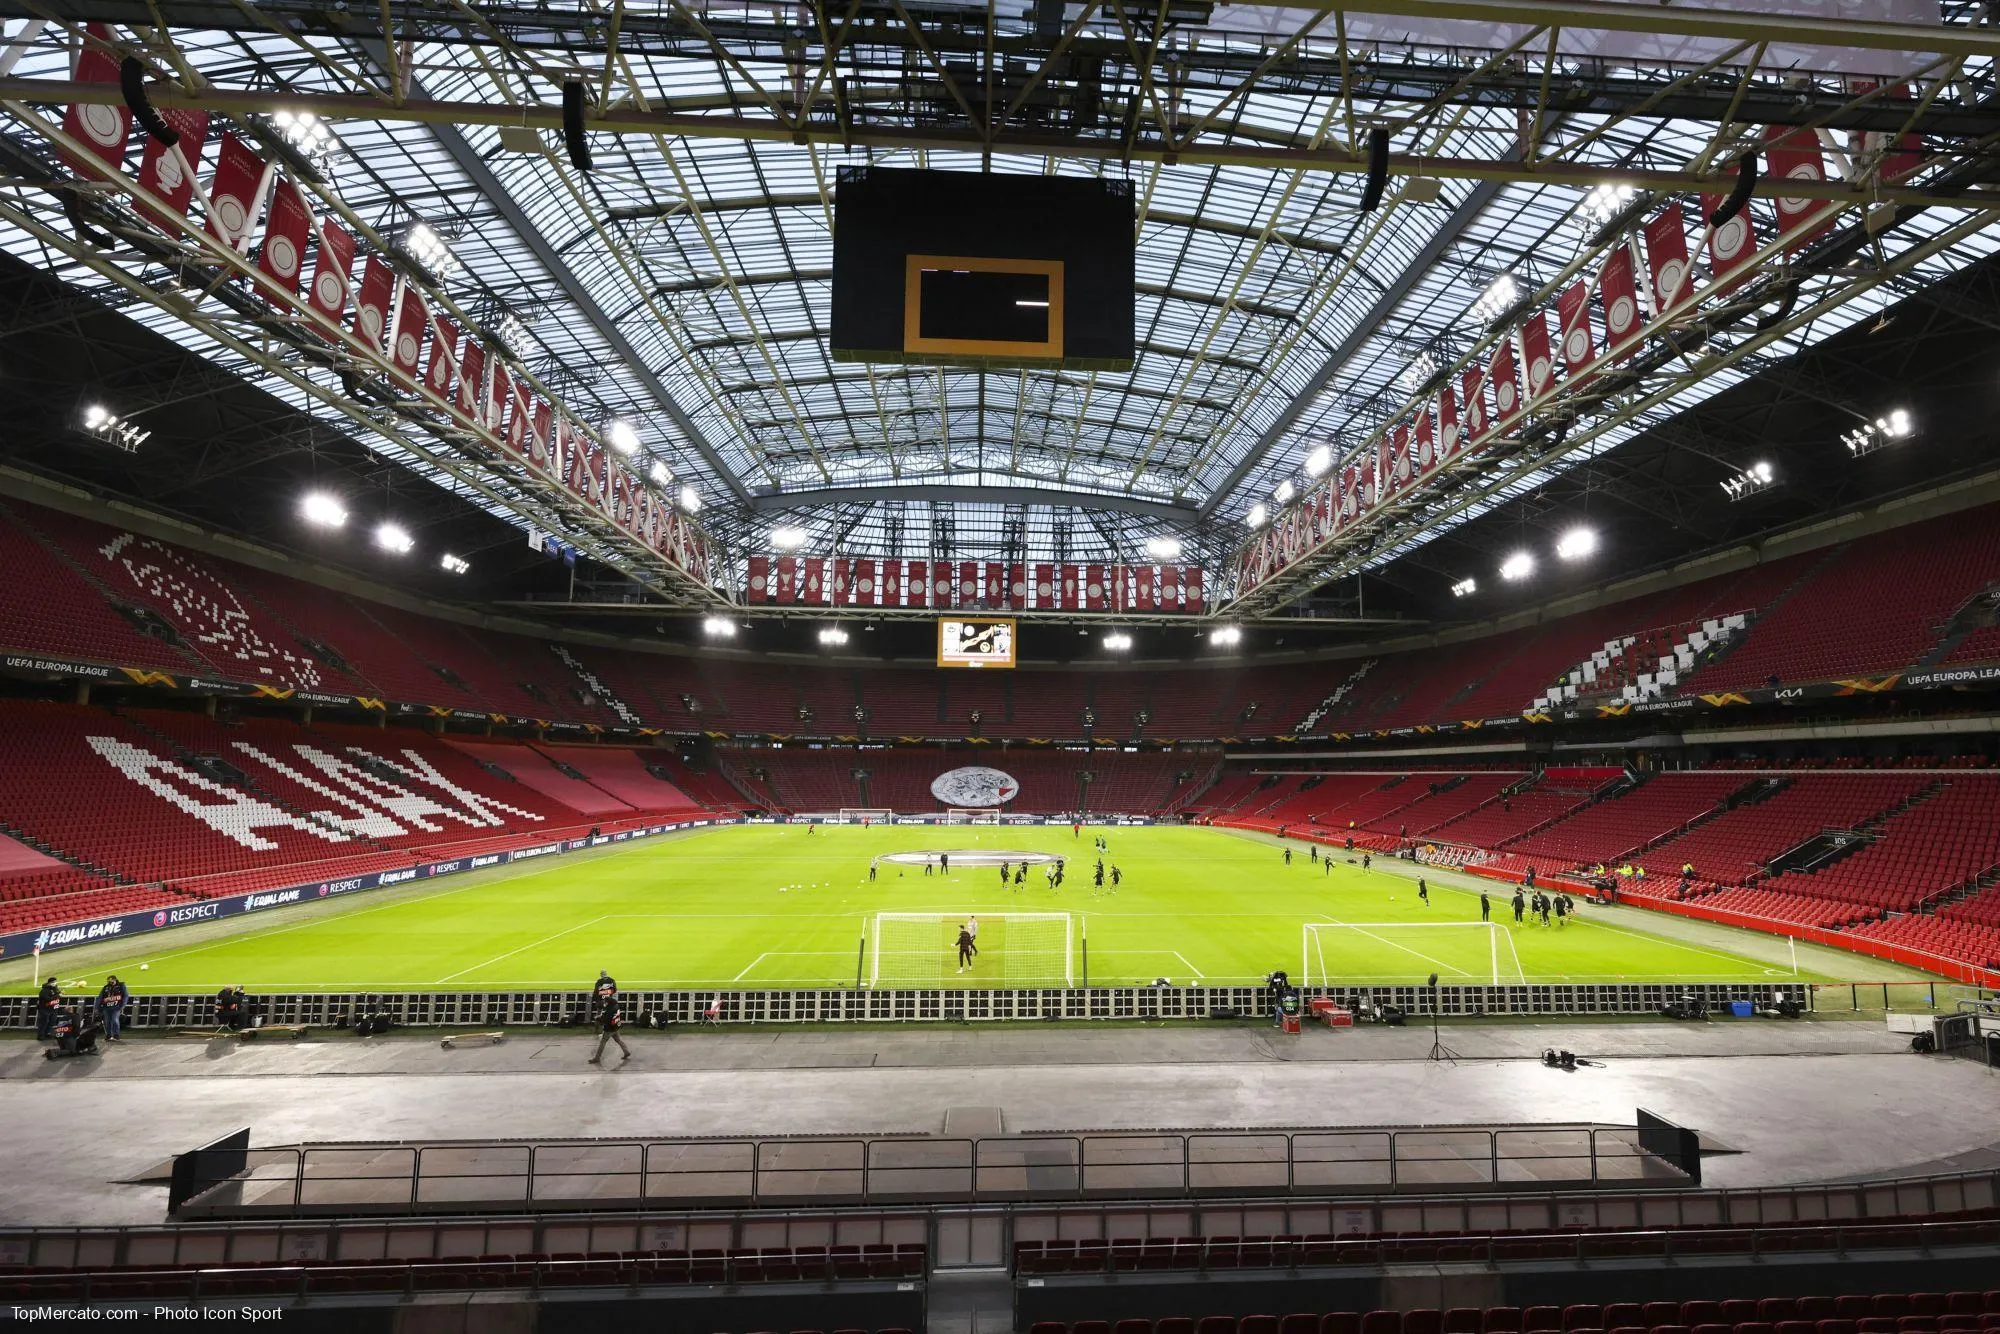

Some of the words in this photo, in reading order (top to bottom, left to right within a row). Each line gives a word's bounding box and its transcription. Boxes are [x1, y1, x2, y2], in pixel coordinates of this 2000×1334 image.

[7, 657, 33, 669] UEFA
[35, 661, 73, 673] EUROPA
[74, 665, 109, 677] LEAGUE
[1907, 675, 1931, 685] UEFA
[1933, 671, 1977, 682] EUROPA
[298, 692, 312, 700] UEFA
[312, 694, 331, 702] EUROPA
[332, 695, 350, 704] LEAGUE
[1649, 702, 1670, 710] EUROPA
[1671, 700, 1693, 708] LEAGUE
[436, 861, 460, 873] RESPECT
[329, 878, 362, 893] RESPECT
[244, 893, 277, 911] #EQUAL
[278, 889, 300, 902] GAME
[170, 903, 219, 922] RESPECT
[34, 925, 87, 949] #EQUAL
[88, 920, 123, 939] GAME
